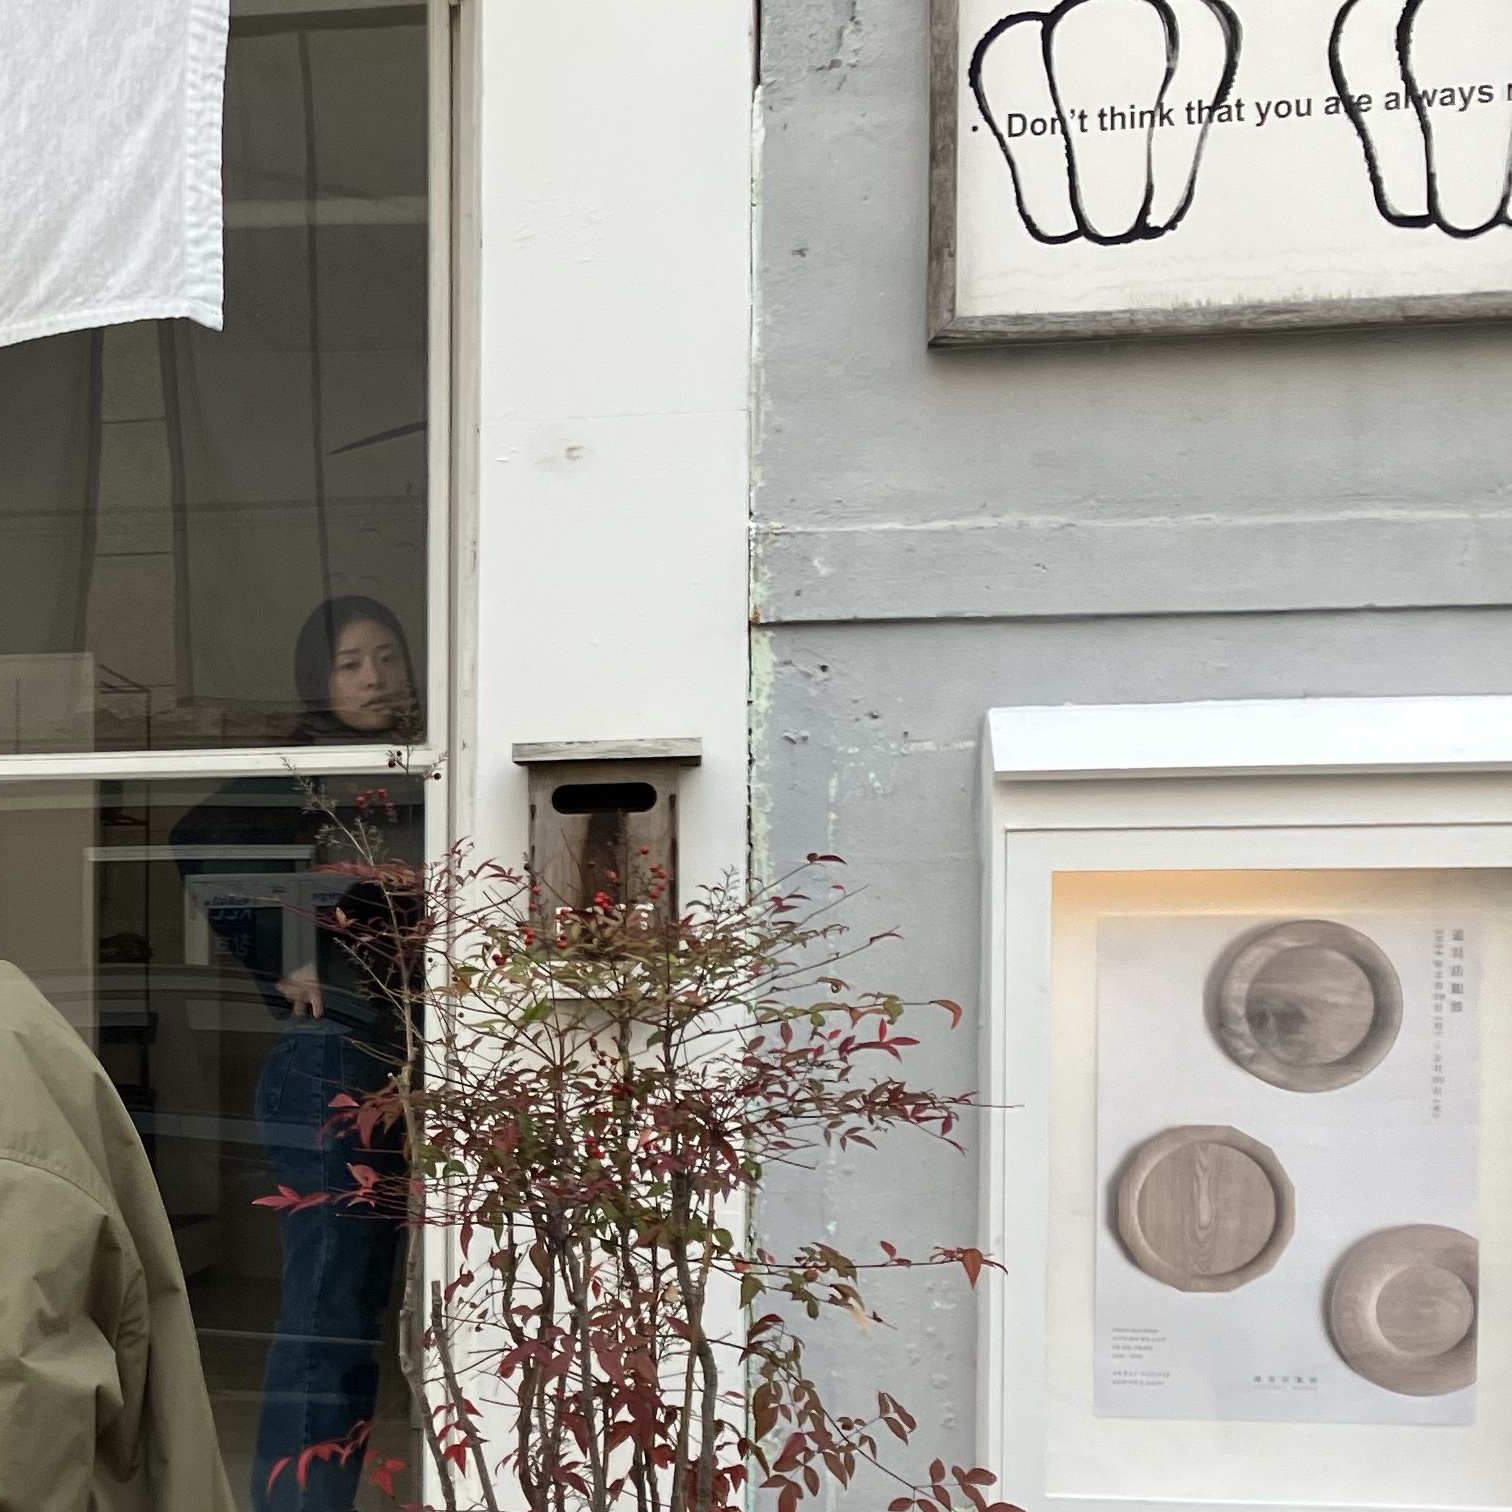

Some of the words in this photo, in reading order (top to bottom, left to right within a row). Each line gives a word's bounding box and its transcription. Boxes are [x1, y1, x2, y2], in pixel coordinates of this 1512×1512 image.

[1097, 102, 1176, 132] think
[1185, 98, 1245, 126] that
[1255, 96, 1313, 127] you
[1384, 84, 1495, 113] always
